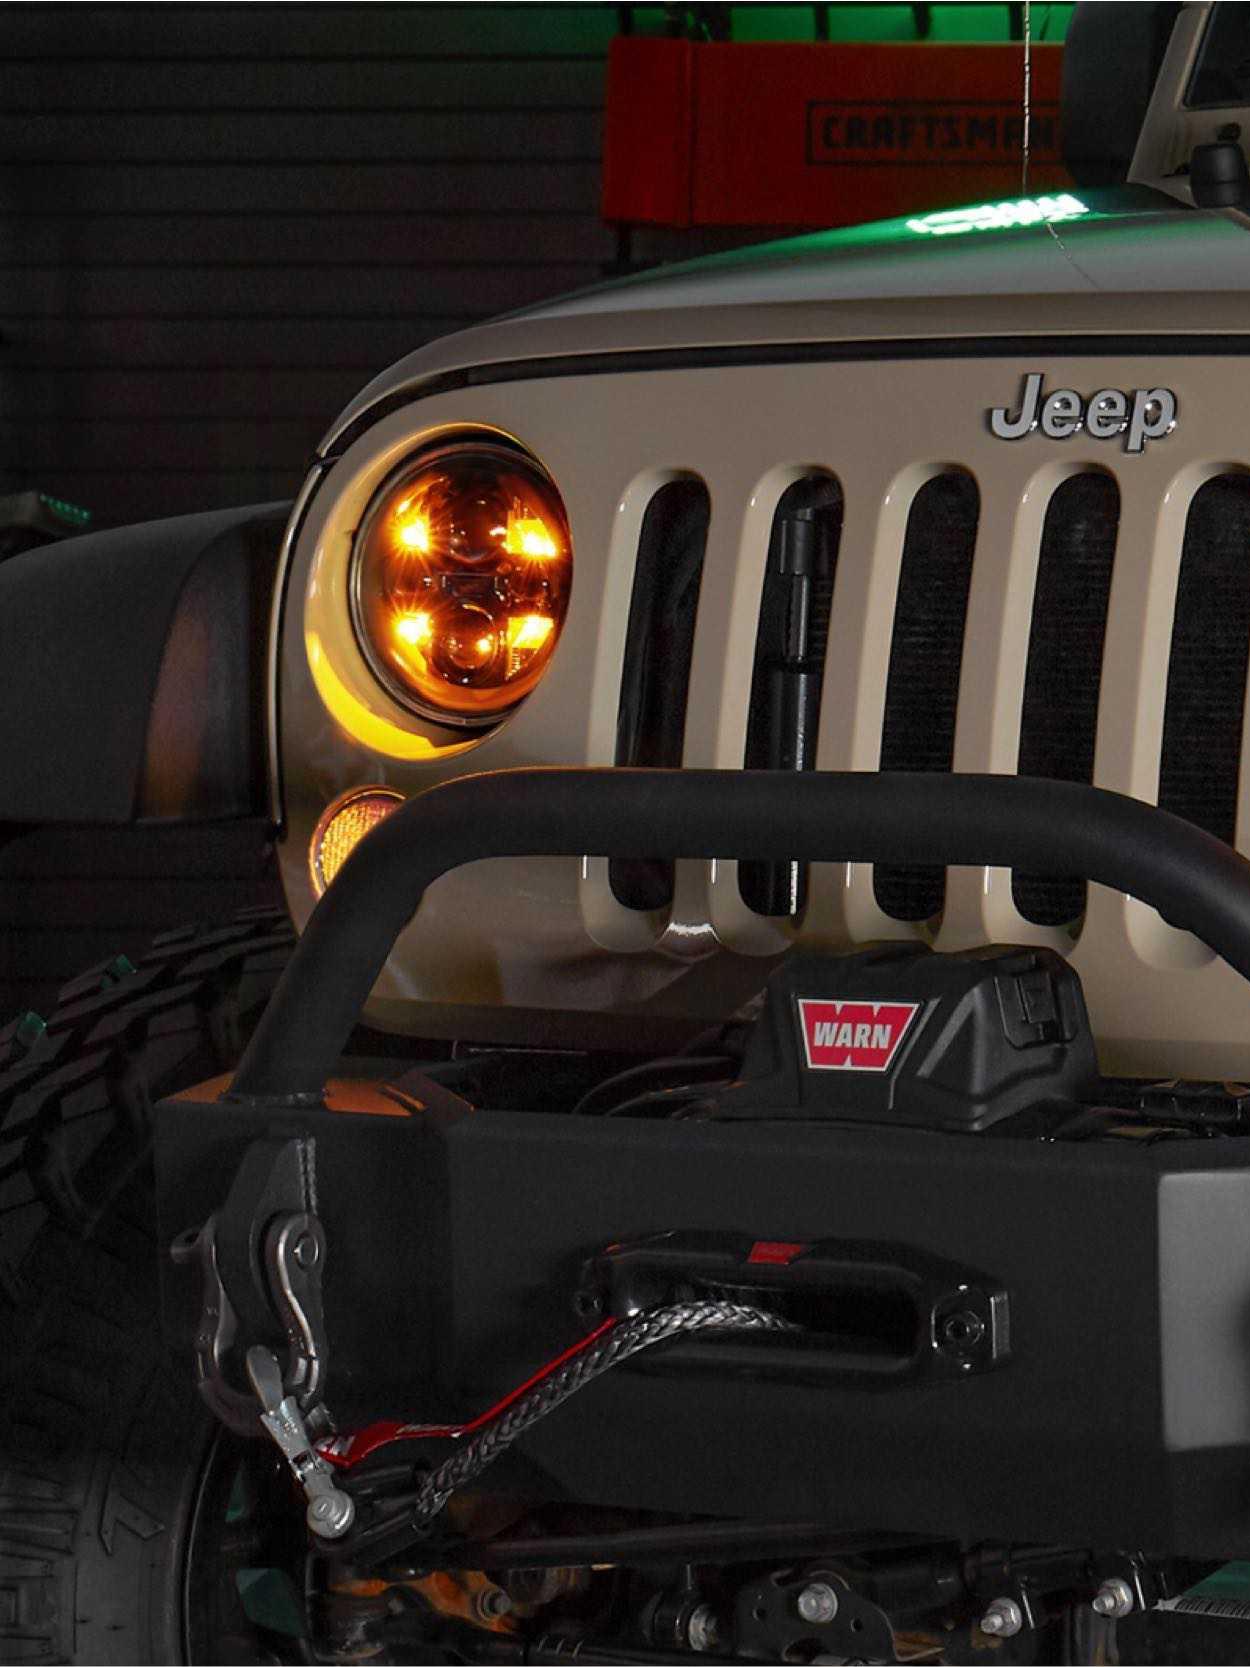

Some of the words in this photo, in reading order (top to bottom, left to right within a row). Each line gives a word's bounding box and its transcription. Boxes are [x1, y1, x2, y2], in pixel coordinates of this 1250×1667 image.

[822, 115, 1057, 149] CRAFTSMAN
[989, 373, 1177, 454] Jeep
[814, 1022, 892, 1049] WARN
